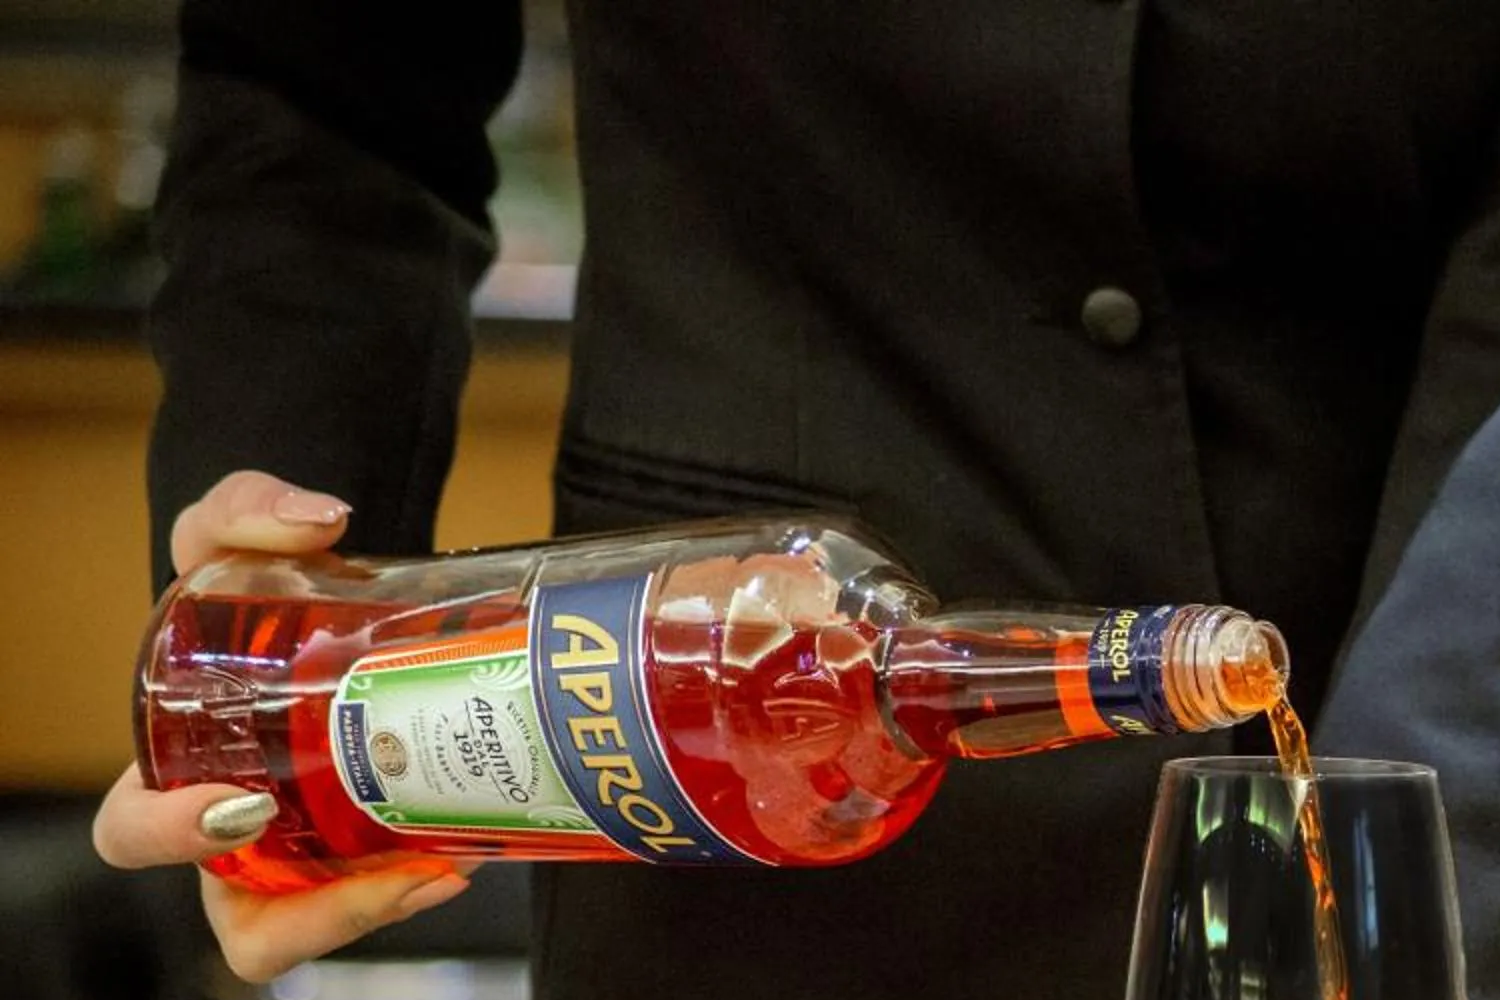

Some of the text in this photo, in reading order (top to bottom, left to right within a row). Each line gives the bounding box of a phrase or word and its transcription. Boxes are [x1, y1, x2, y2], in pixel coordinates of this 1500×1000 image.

[1109, 610, 1138, 682] APEROL
[453, 732, 484, 777] 1919
[472, 696, 529, 803] APERITIVO
[473, 739, 490, 768] DAL
[551, 614, 697, 853] APEROL
